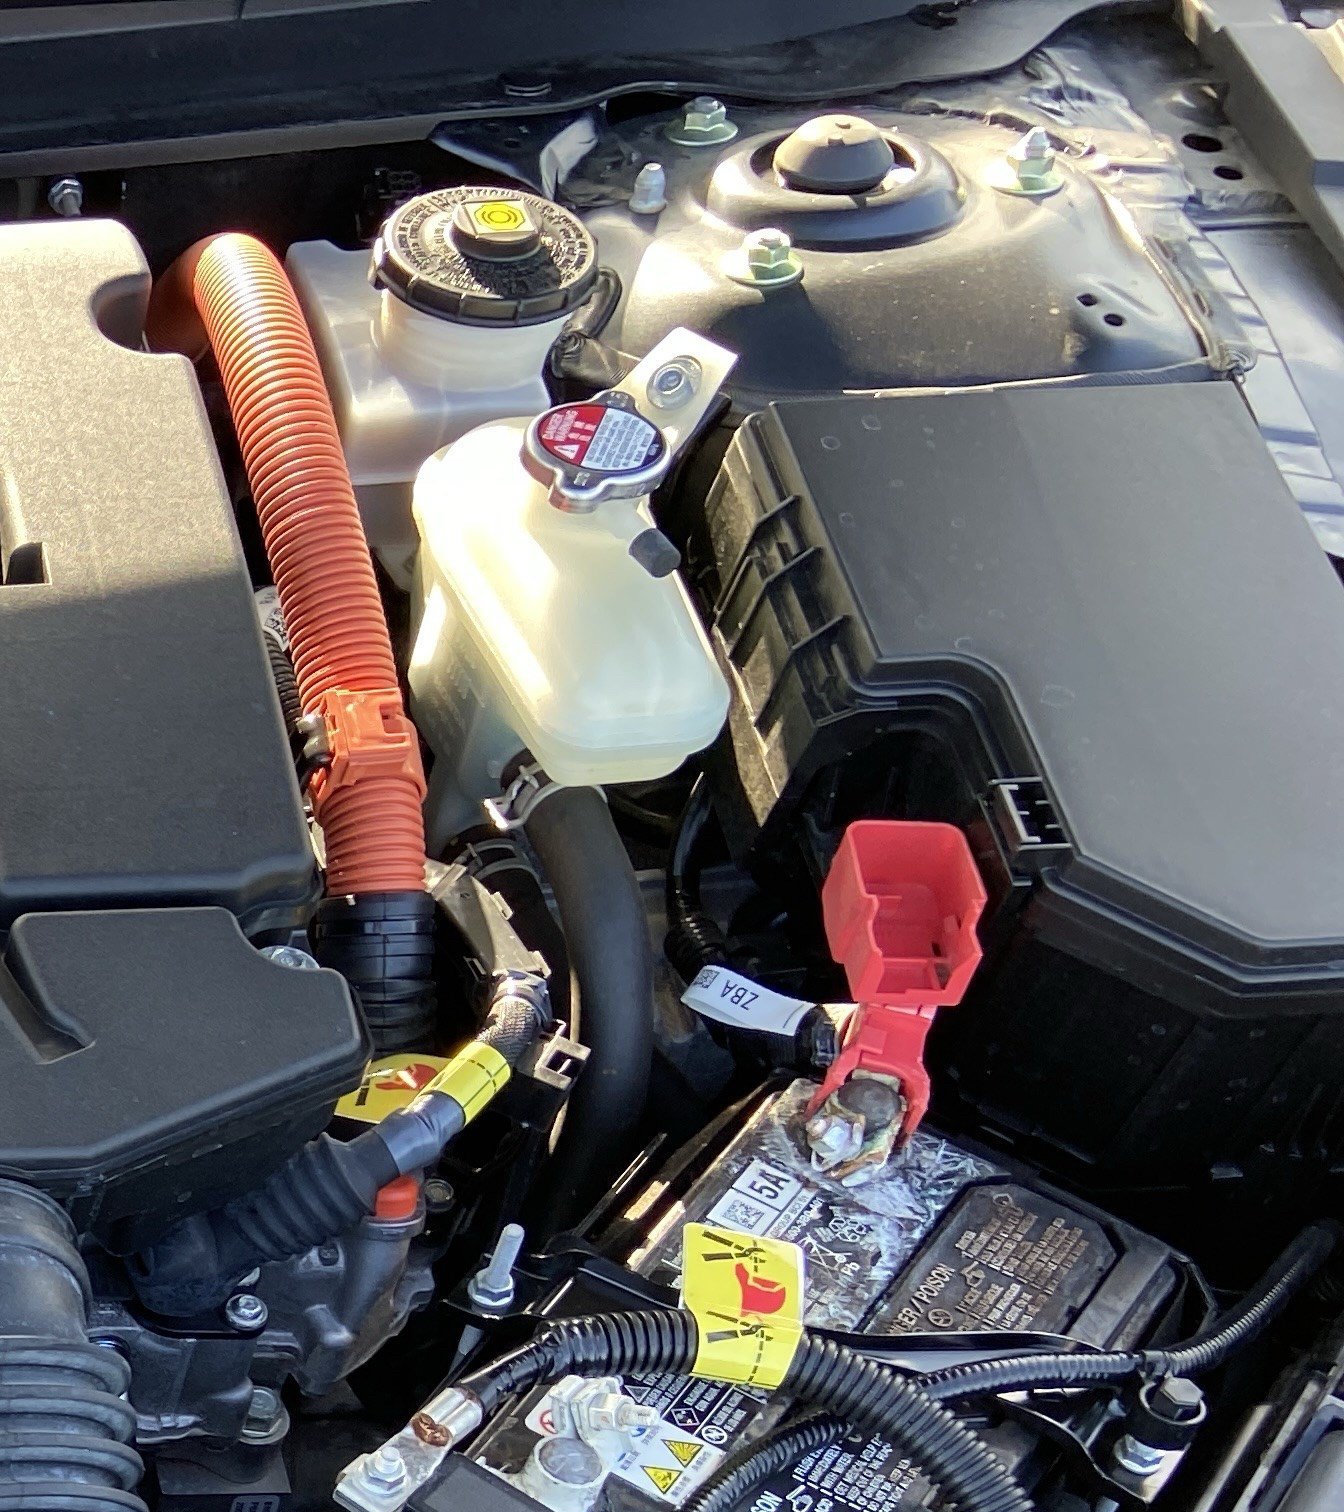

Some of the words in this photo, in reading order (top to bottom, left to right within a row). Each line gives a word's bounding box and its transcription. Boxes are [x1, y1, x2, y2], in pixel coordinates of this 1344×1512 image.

[720, 979, 760, 1011] ZBA
[753, 1168, 789, 1201] 5A
[841, 1262, 861, 1278] Pb
[914, 1263, 955, 1303] POISON
